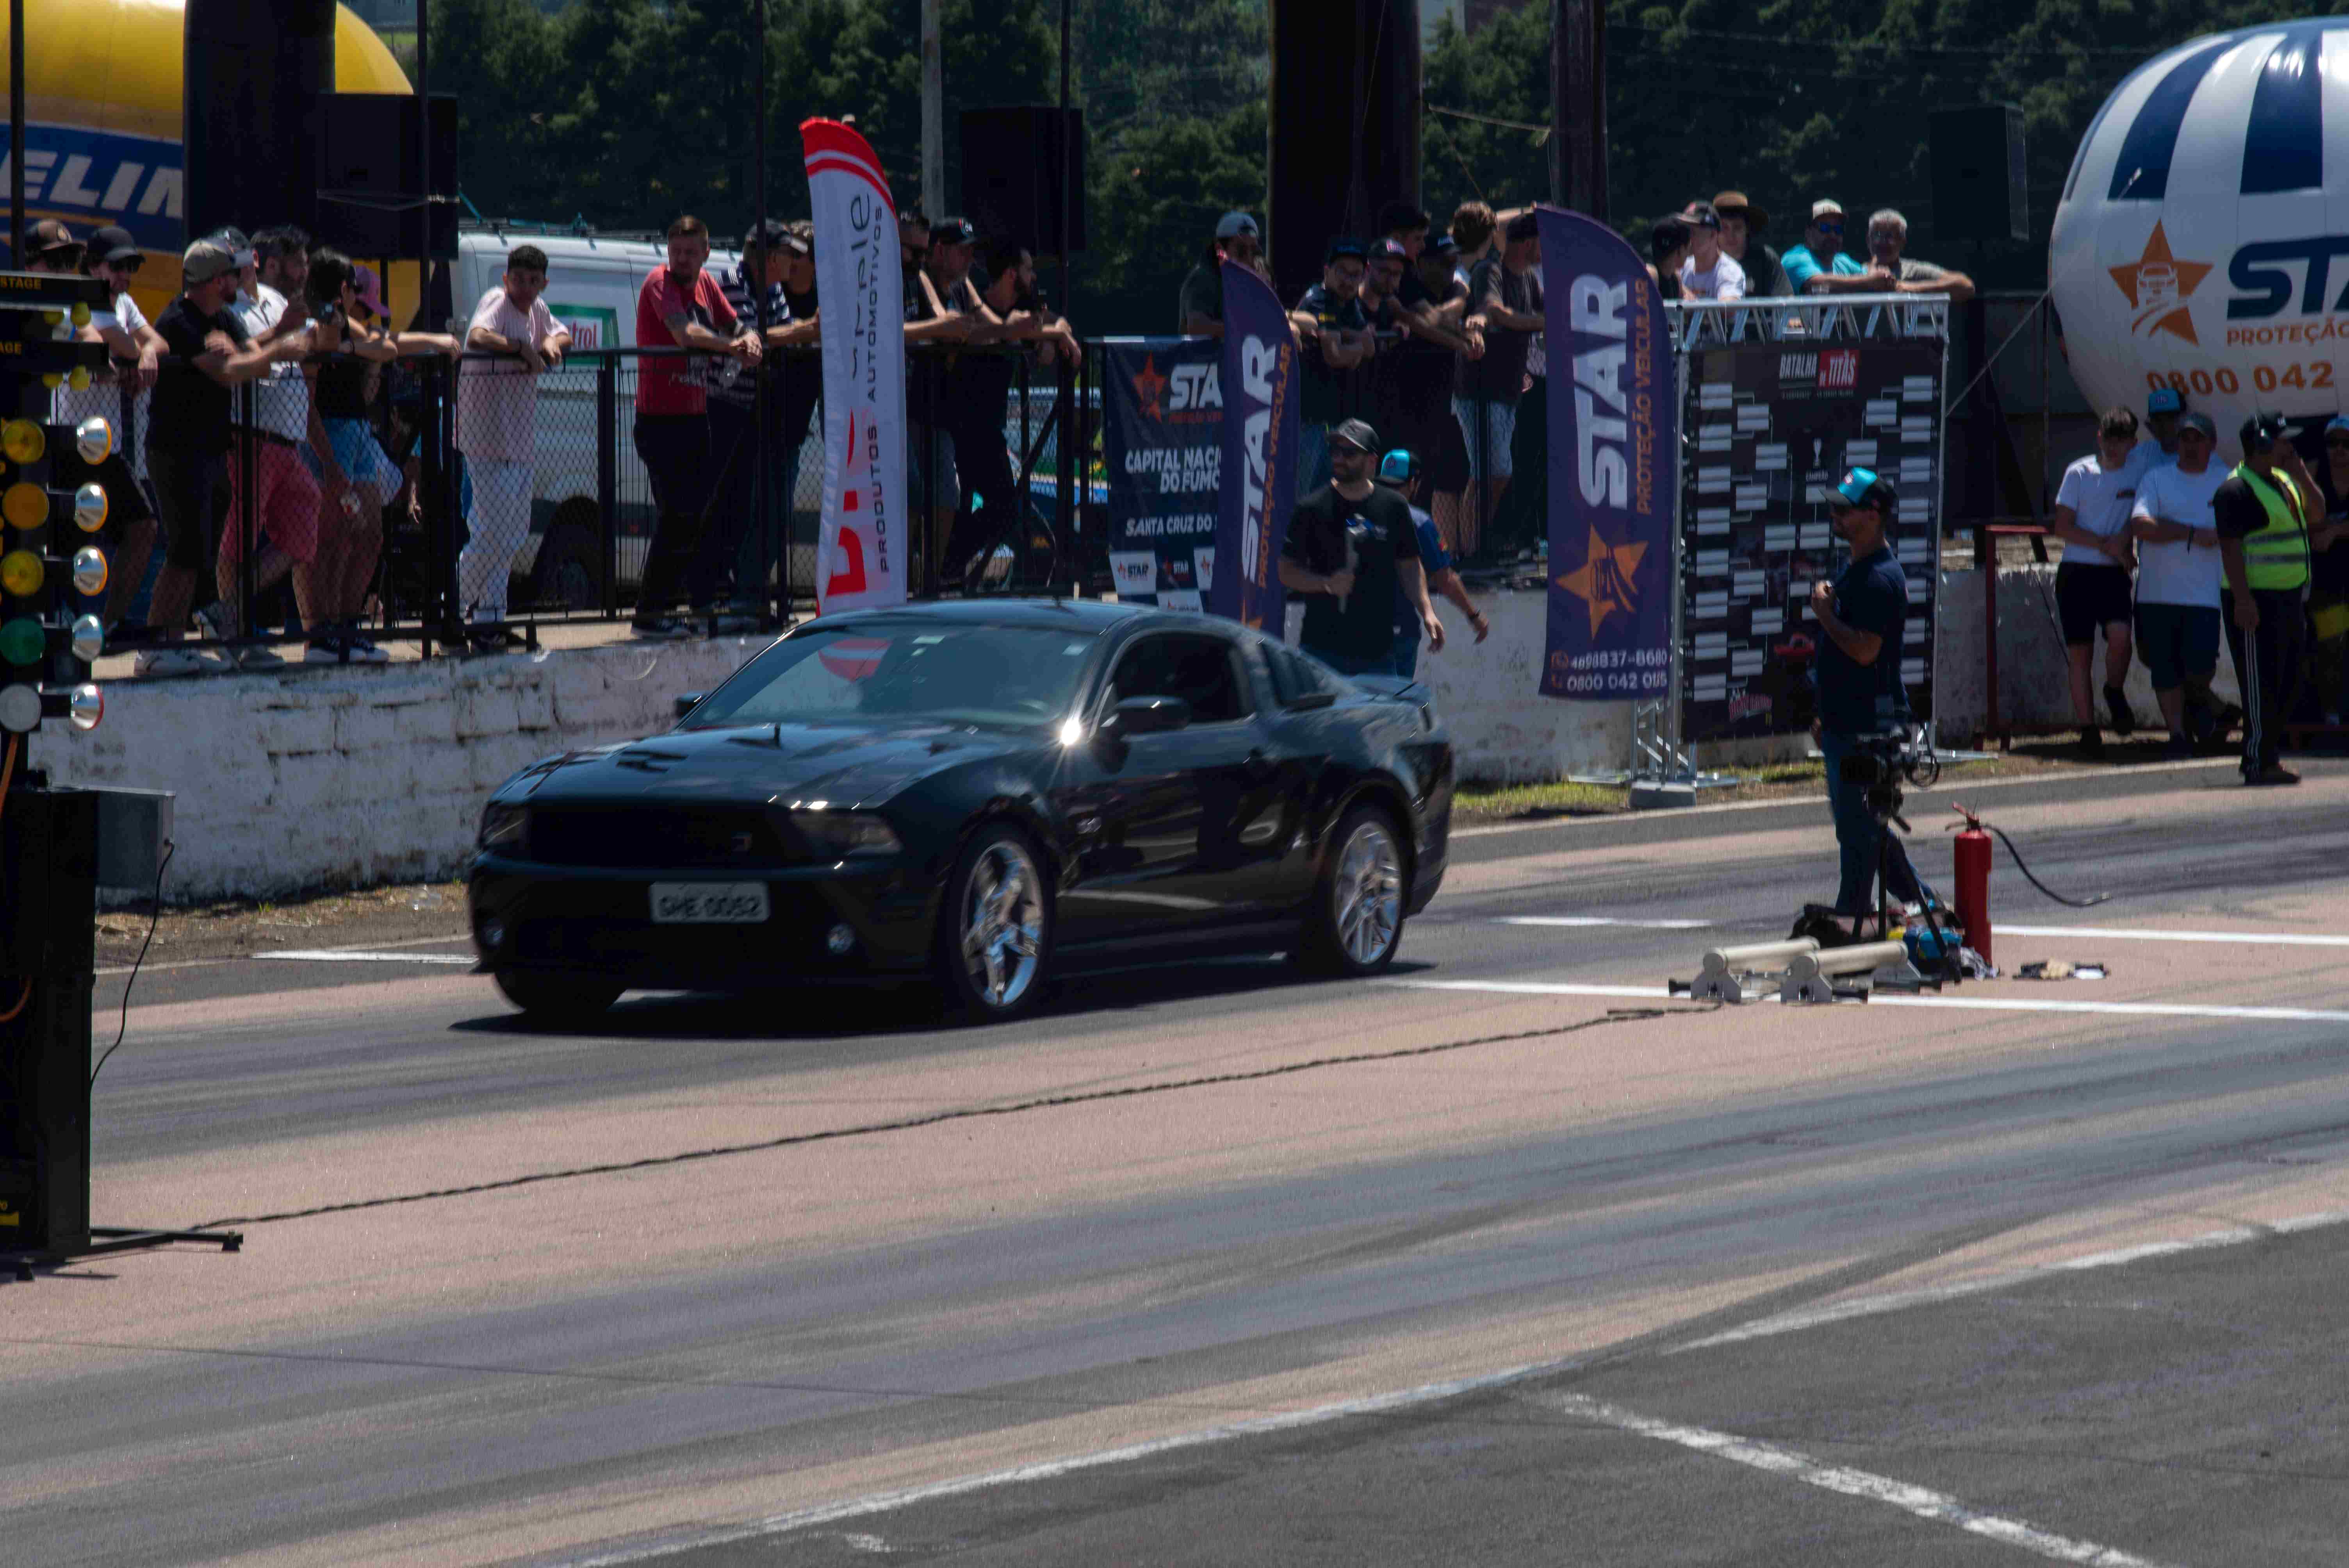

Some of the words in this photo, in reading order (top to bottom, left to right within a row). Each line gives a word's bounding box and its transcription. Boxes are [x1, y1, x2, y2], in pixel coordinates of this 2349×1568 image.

[868, 206, 882, 403] AUTOMOTIVOS
[2227, 234, 2349, 321] ST
[1635, 278, 1650, 388] VEICULAR
[1779, 352, 1818, 379] BATALHA
[1169, 362, 1224, 410] STA
[1570, 273, 1627, 510] STAR
[2147, 366, 2239, 397] 0800
[2253, 360, 2335, 393] 042
[1125, 448, 1181, 474] CAPITAL
[1160, 470, 1180, 494] DO
[1241, 334, 1276, 584] STAR
[1258, 461, 1275, 588] PROTEÇÃO
[1270, 341, 1292, 456] VEICULAR
[1633, 393, 1657, 515] PROTEÇÃO
[868, 426, 889, 573] PRODUTOS
[1125, 516, 1164, 537] SANTA
[1166, 513, 1194, 535] CRUZ
[1196, 512, 1212, 533] DO
[1567, 673, 1603, 692] 0800
[1608, 671, 1638, 690] 042
